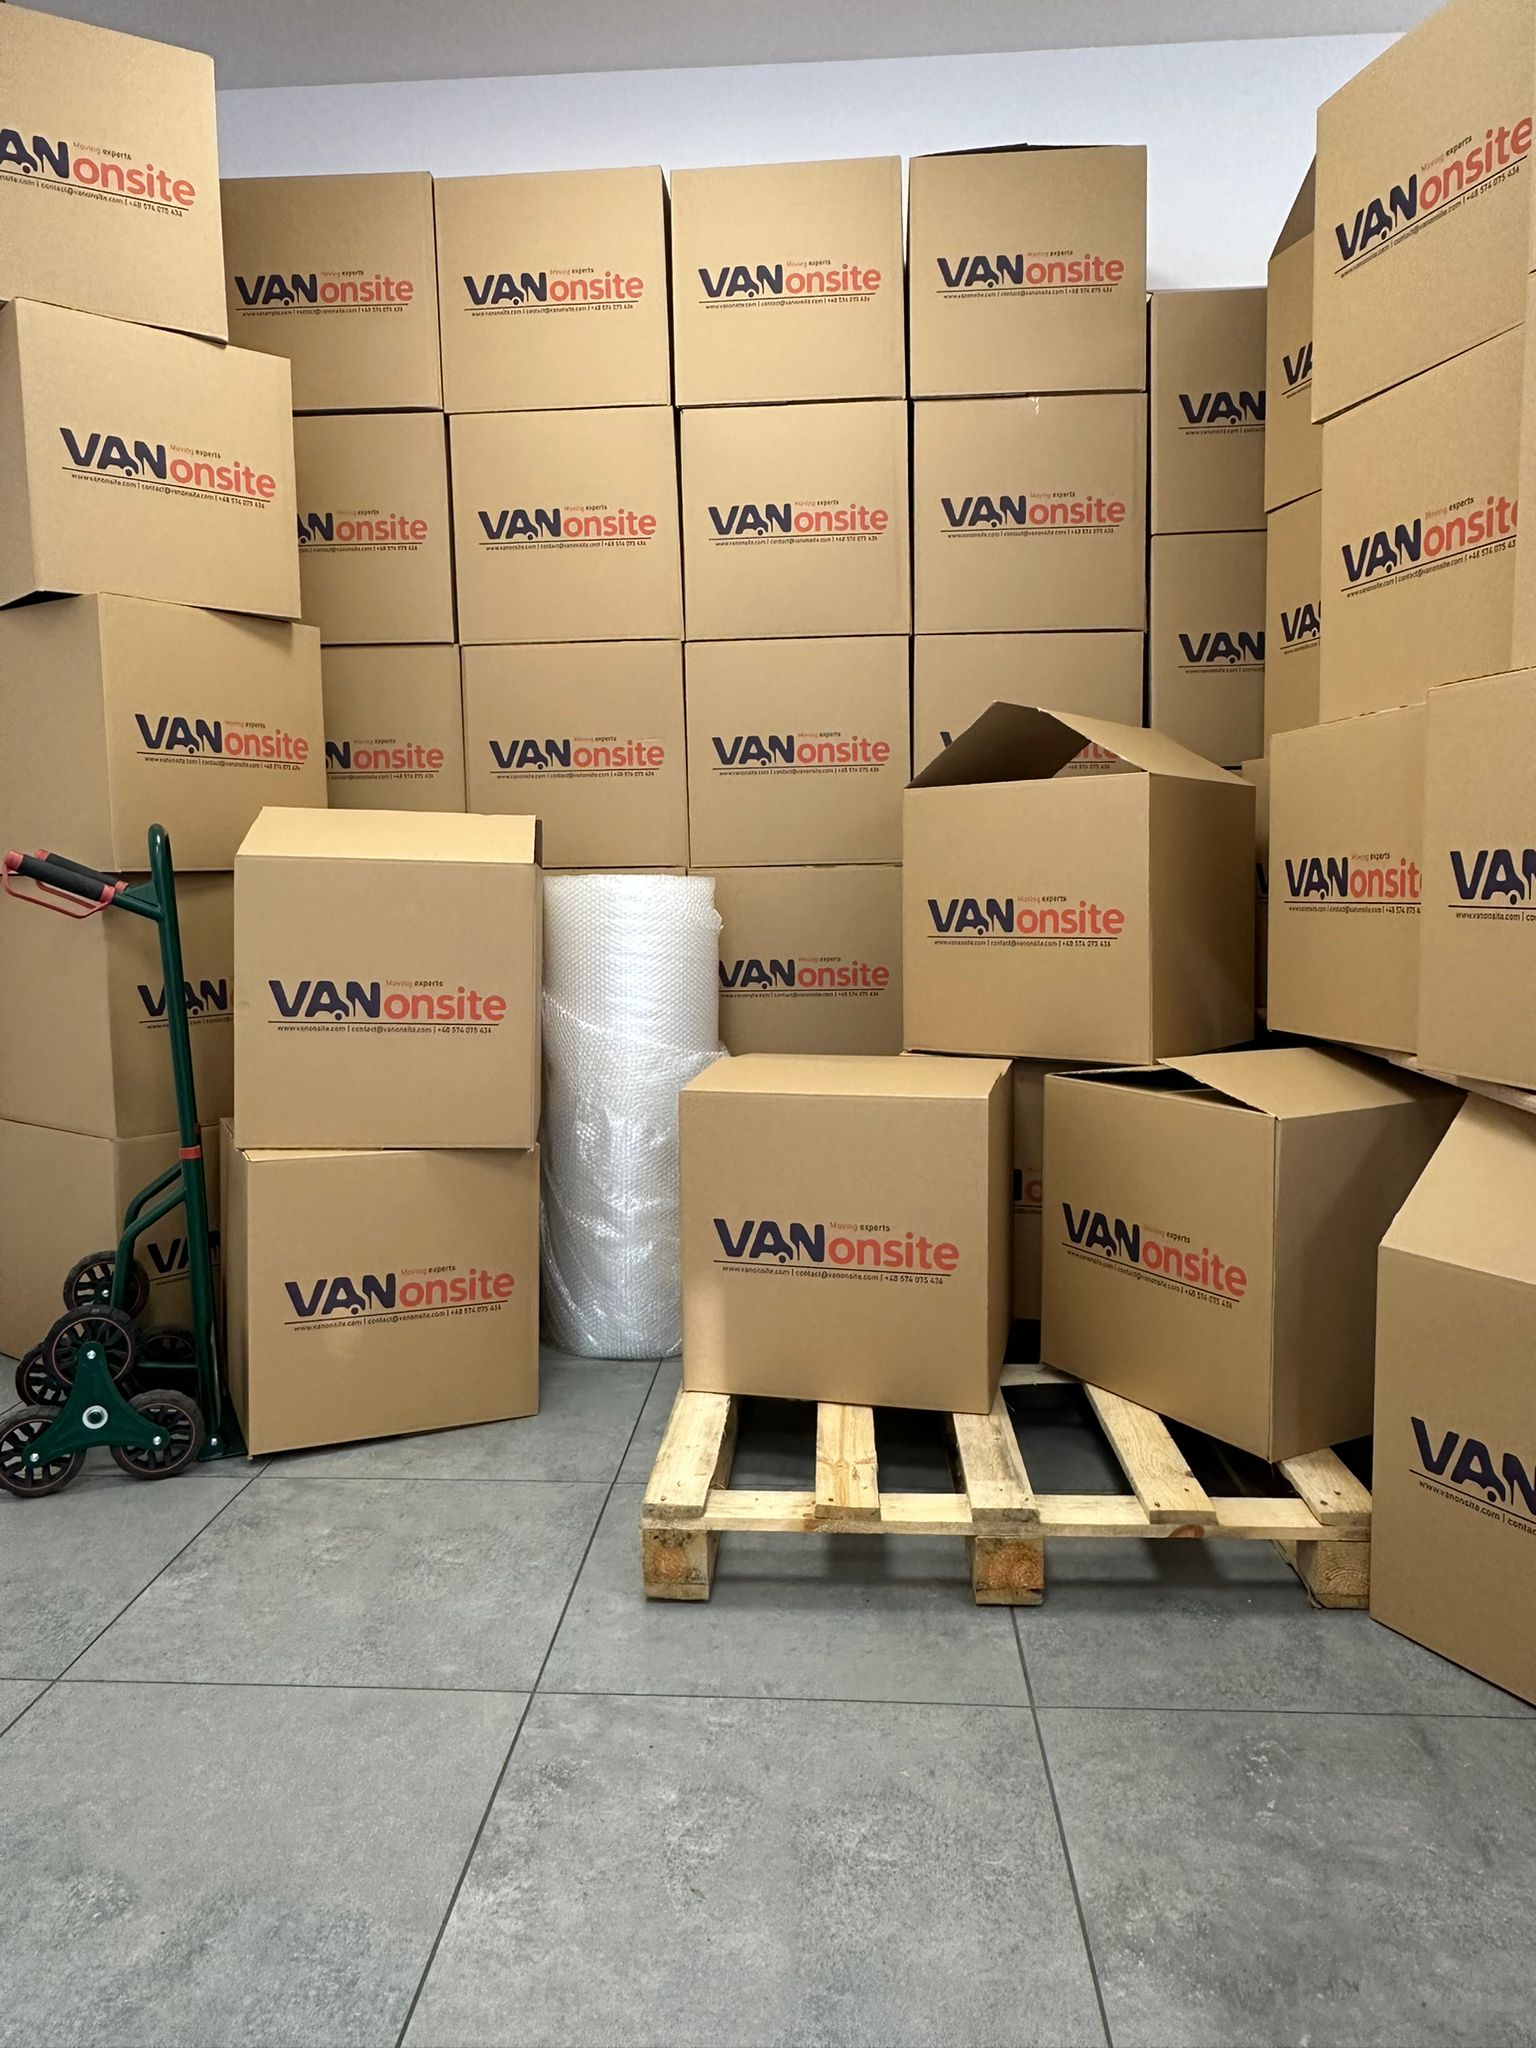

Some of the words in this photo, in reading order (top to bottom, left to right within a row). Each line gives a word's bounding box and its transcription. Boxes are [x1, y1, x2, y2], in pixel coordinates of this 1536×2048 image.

[1446, 134, 1472, 160] experts
[102, 148, 132, 160] experts
[196, 449, 221, 459] experts
[1449, 495, 1474, 514] experts
[1285, 857, 1422, 900] VANonsit
[414, 980, 443, 988] experts
[860, 1223, 890, 1232] experts
[428, 1265, 456, 1275] experts
